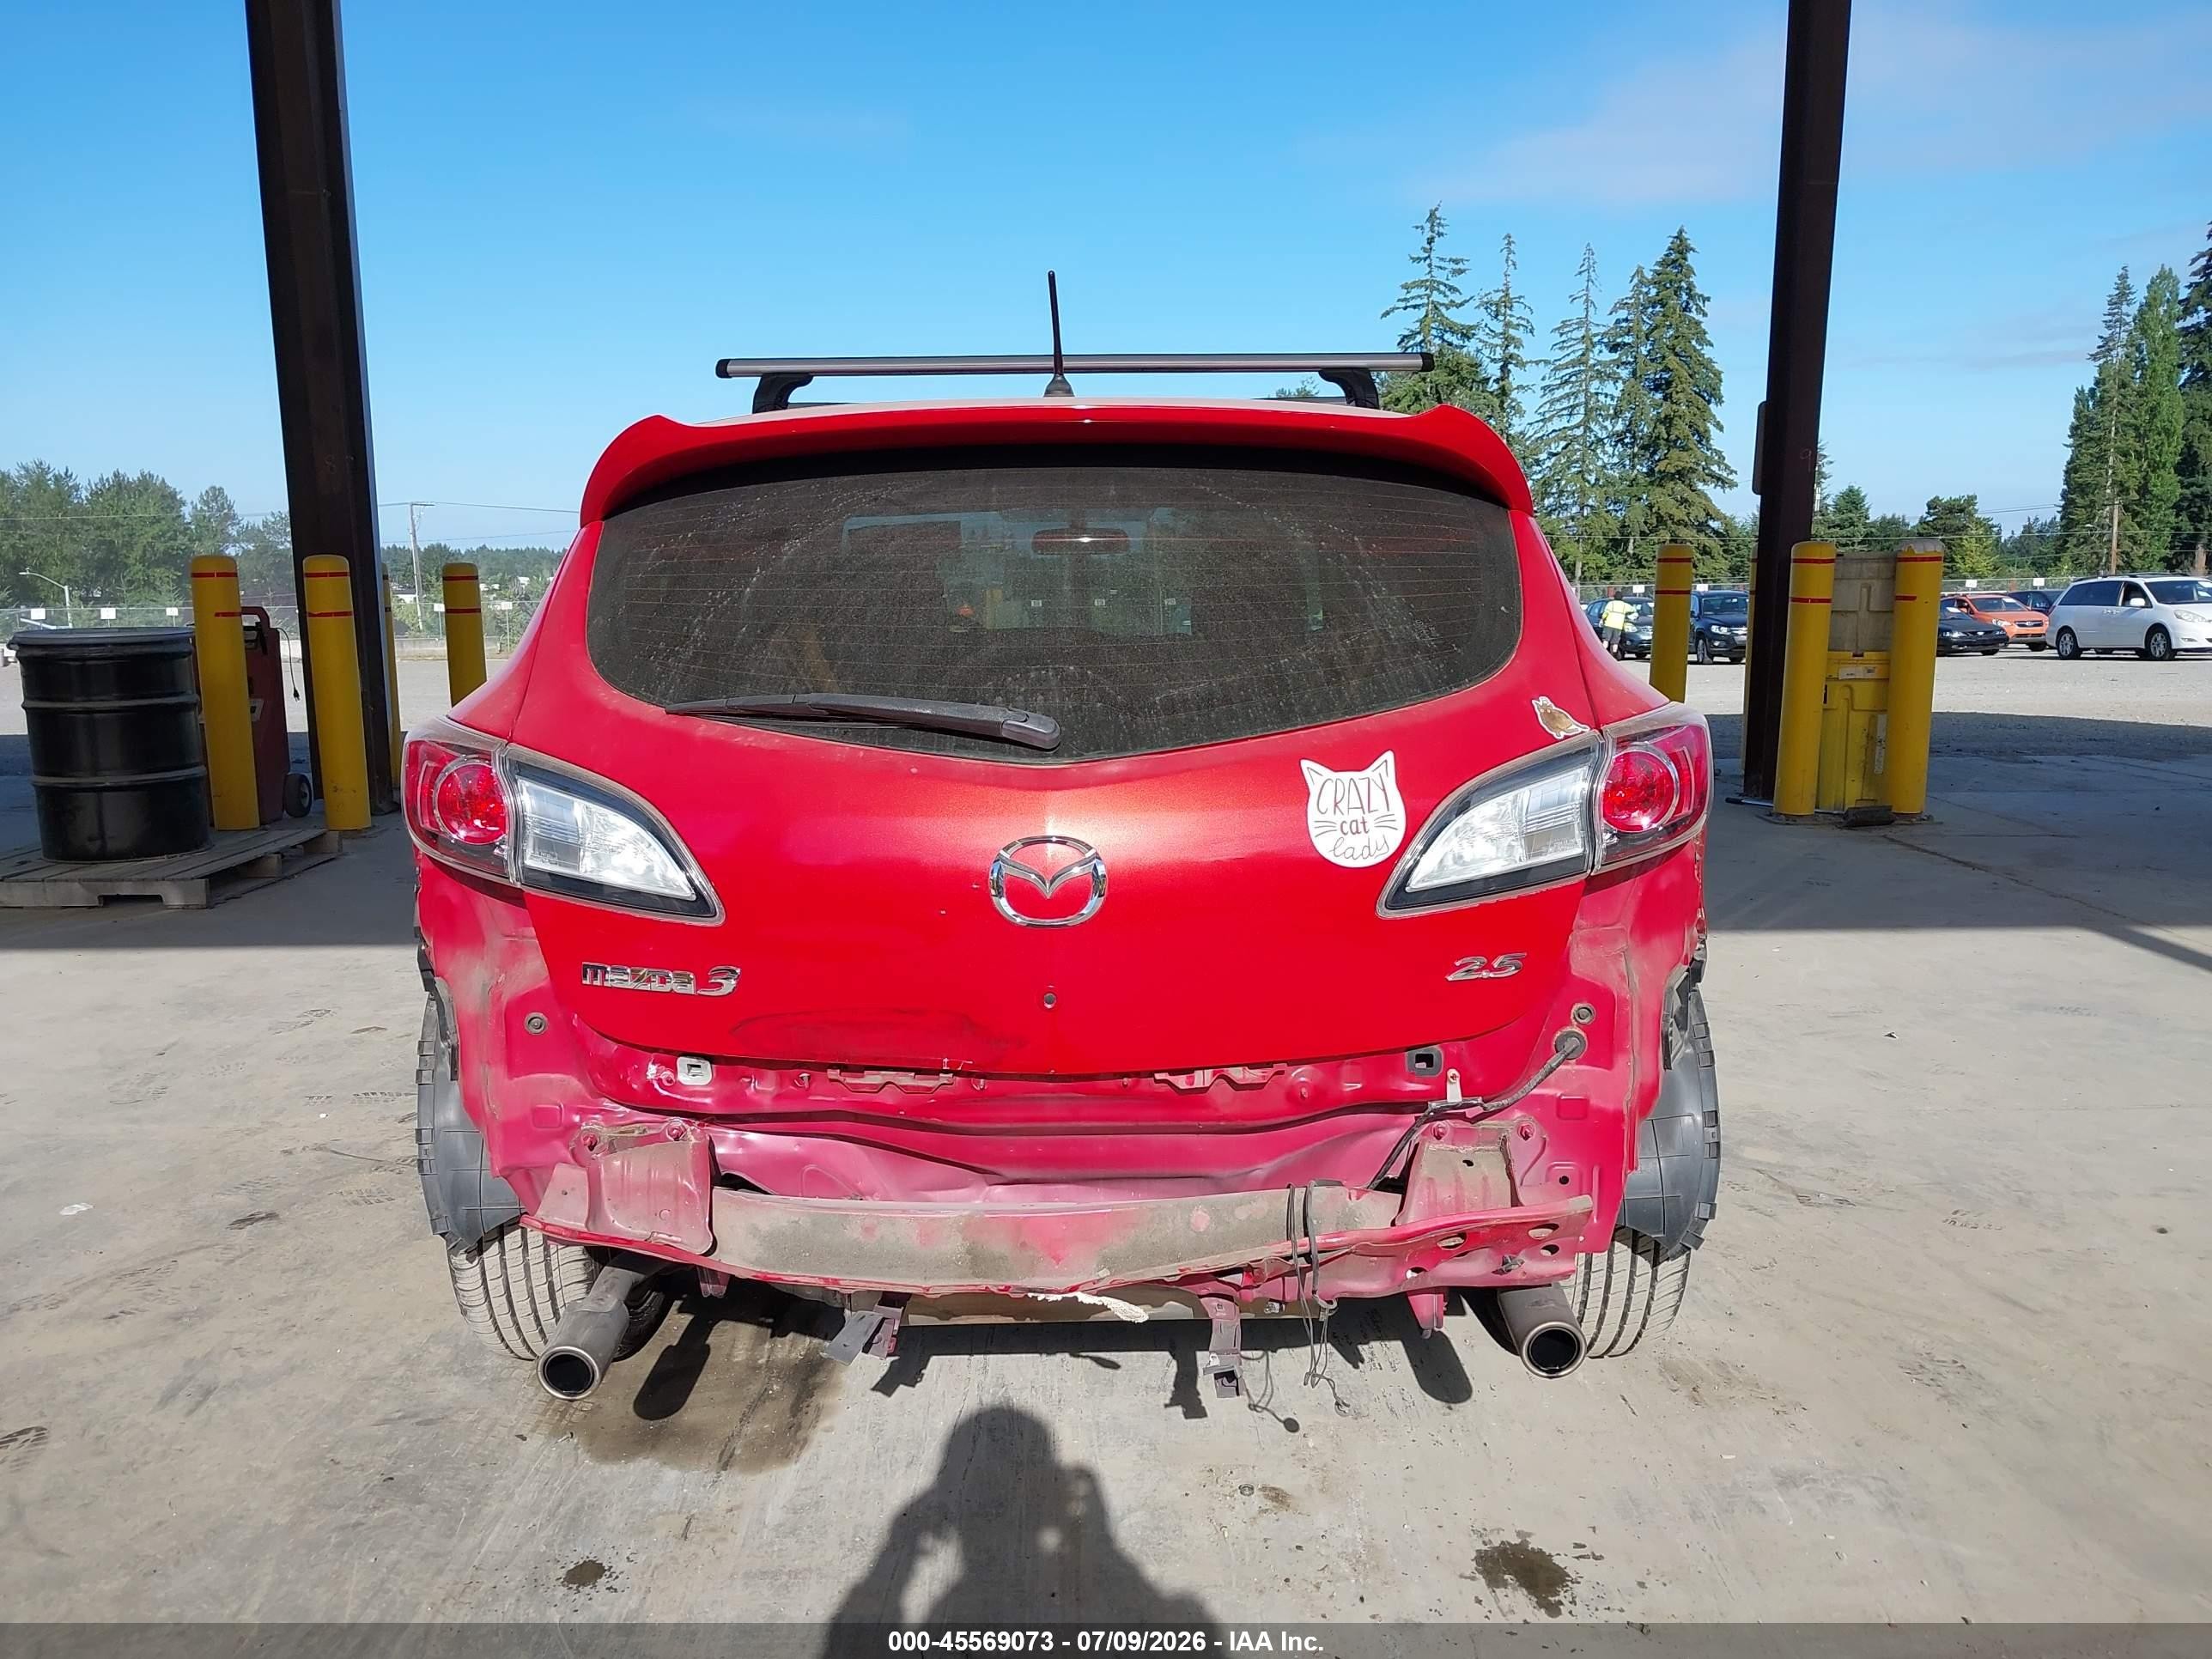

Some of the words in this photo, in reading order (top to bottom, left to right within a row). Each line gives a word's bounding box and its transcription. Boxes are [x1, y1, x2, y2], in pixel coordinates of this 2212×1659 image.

[1316, 773, 1389, 816] CRAZY
[1340, 817, 1370, 836] cat
[1328, 834, 1390, 860] lady
[1445, 952, 1528, 981] 2.5
